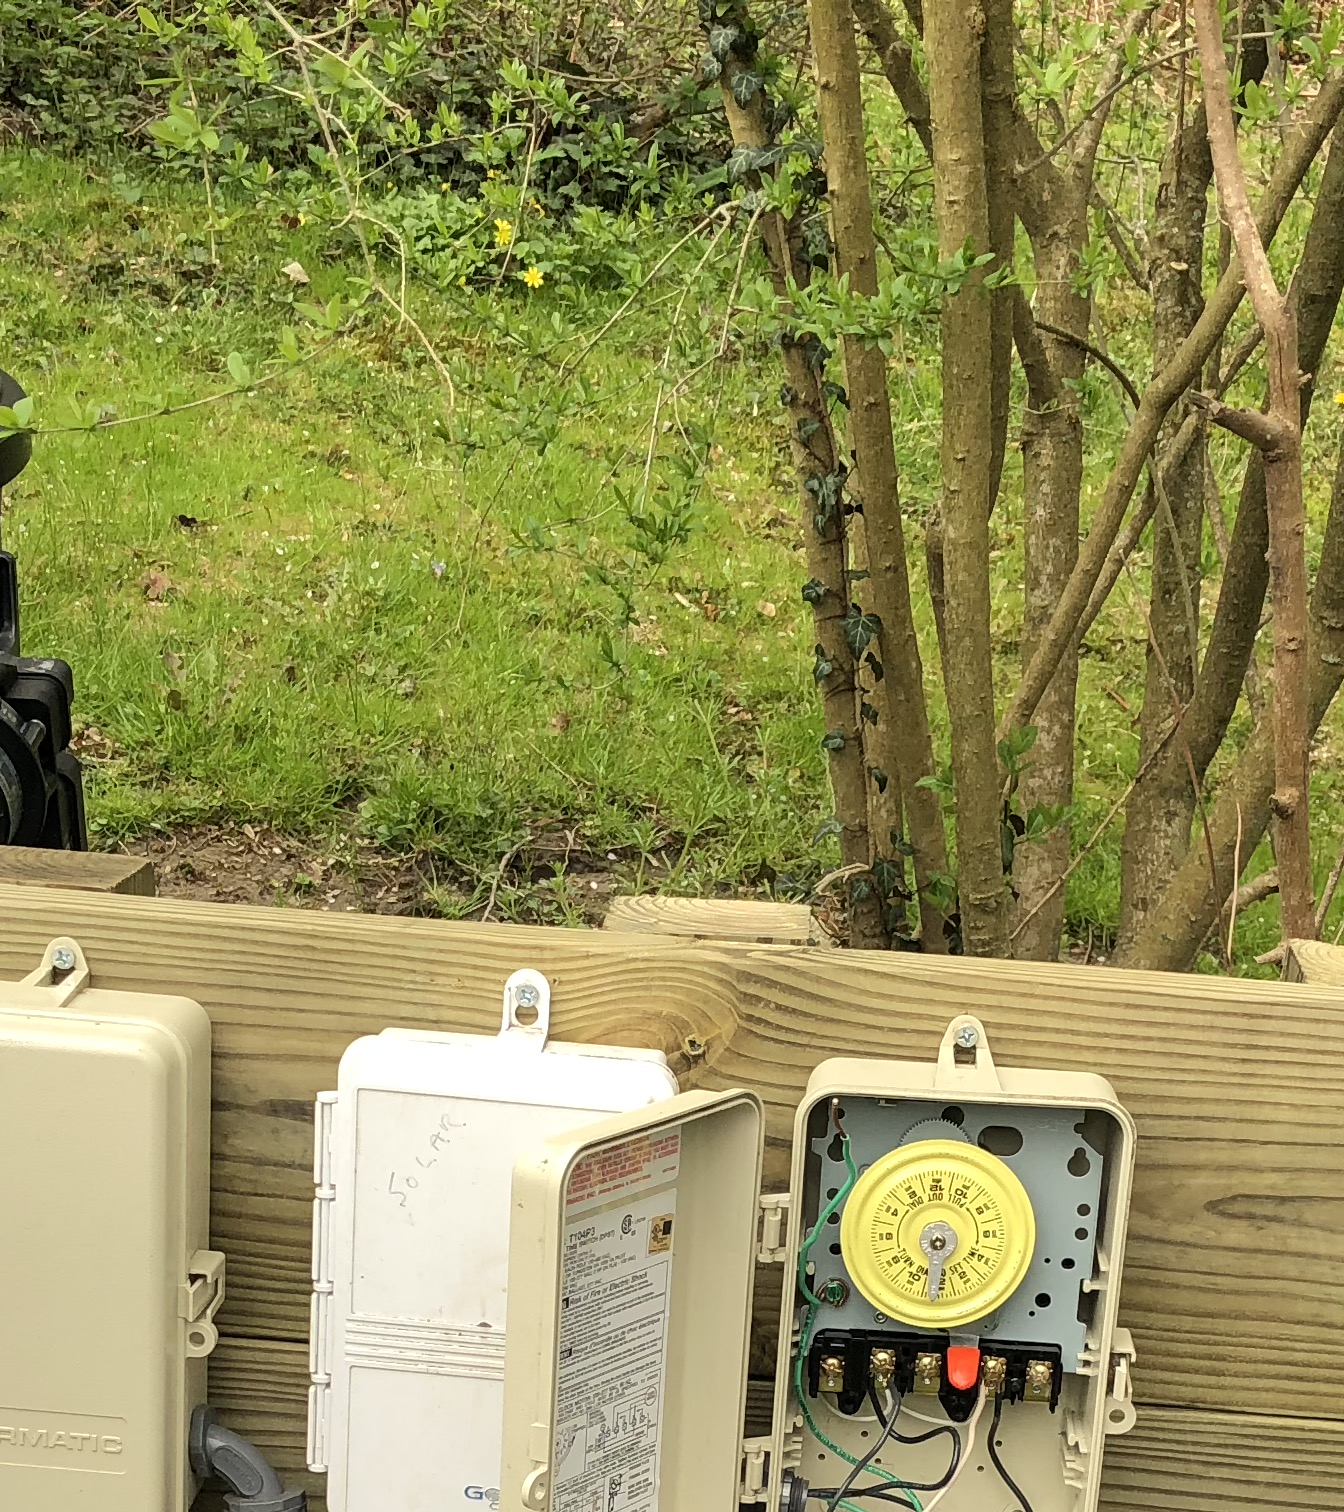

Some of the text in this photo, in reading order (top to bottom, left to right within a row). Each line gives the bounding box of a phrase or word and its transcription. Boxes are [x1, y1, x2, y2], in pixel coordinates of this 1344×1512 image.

[908, 1193, 968, 1211] PULL OUT DIAL
[899, 1246, 916, 1269] TURN
[915, 1264, 929, 1277] DIA
[949, 1261, 964, 1276] SET
[963, 1245, 980, 1264] TIME
[589, 1289, 601, 1298] Fire
